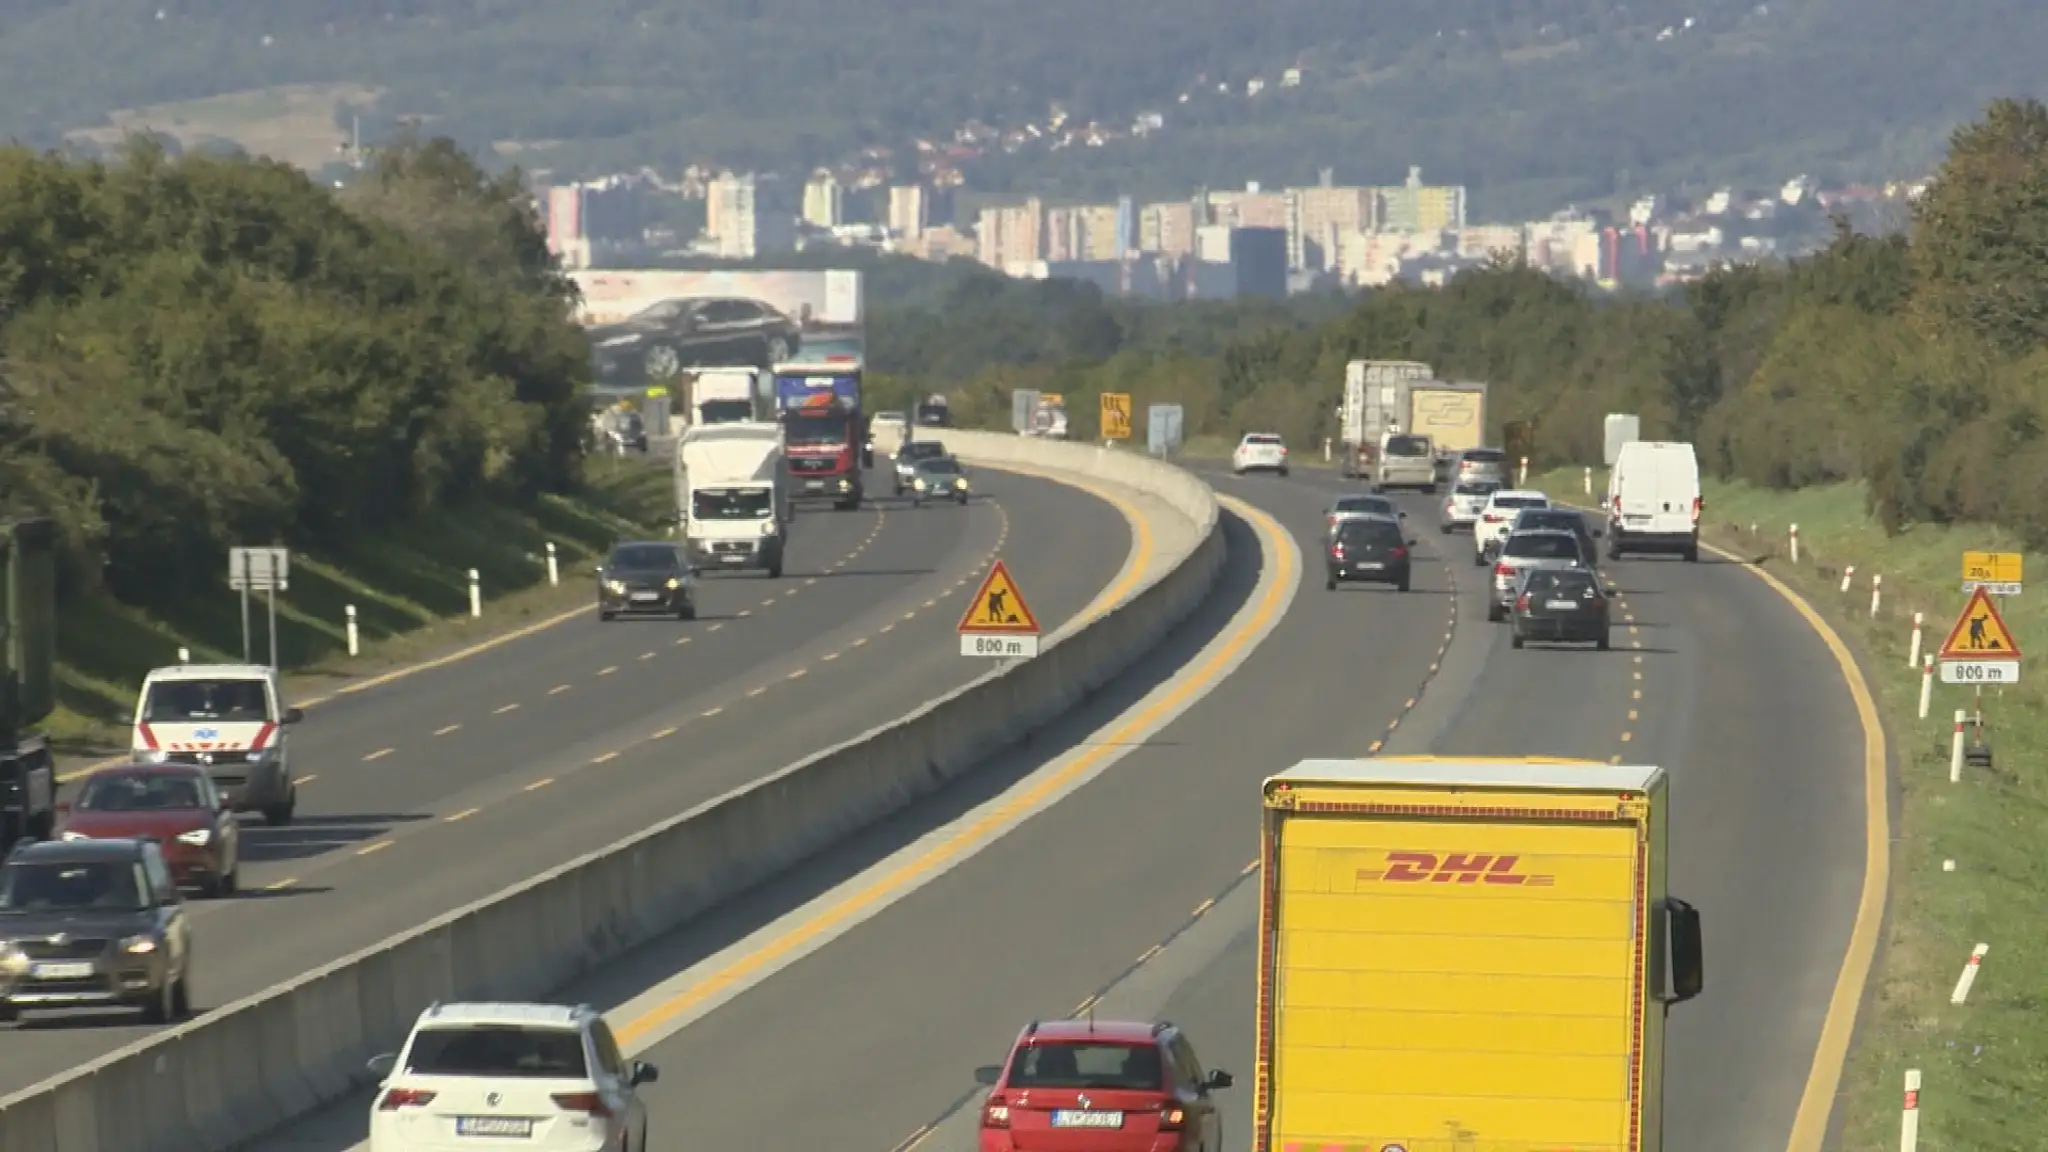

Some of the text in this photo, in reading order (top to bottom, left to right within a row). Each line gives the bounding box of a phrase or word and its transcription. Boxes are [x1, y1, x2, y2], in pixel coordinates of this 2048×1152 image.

[976, 637, 1022, 654] 800 m
[1955, 665, 2003, 680] 800 m
[1383, 852, 1527, 885] DHL
